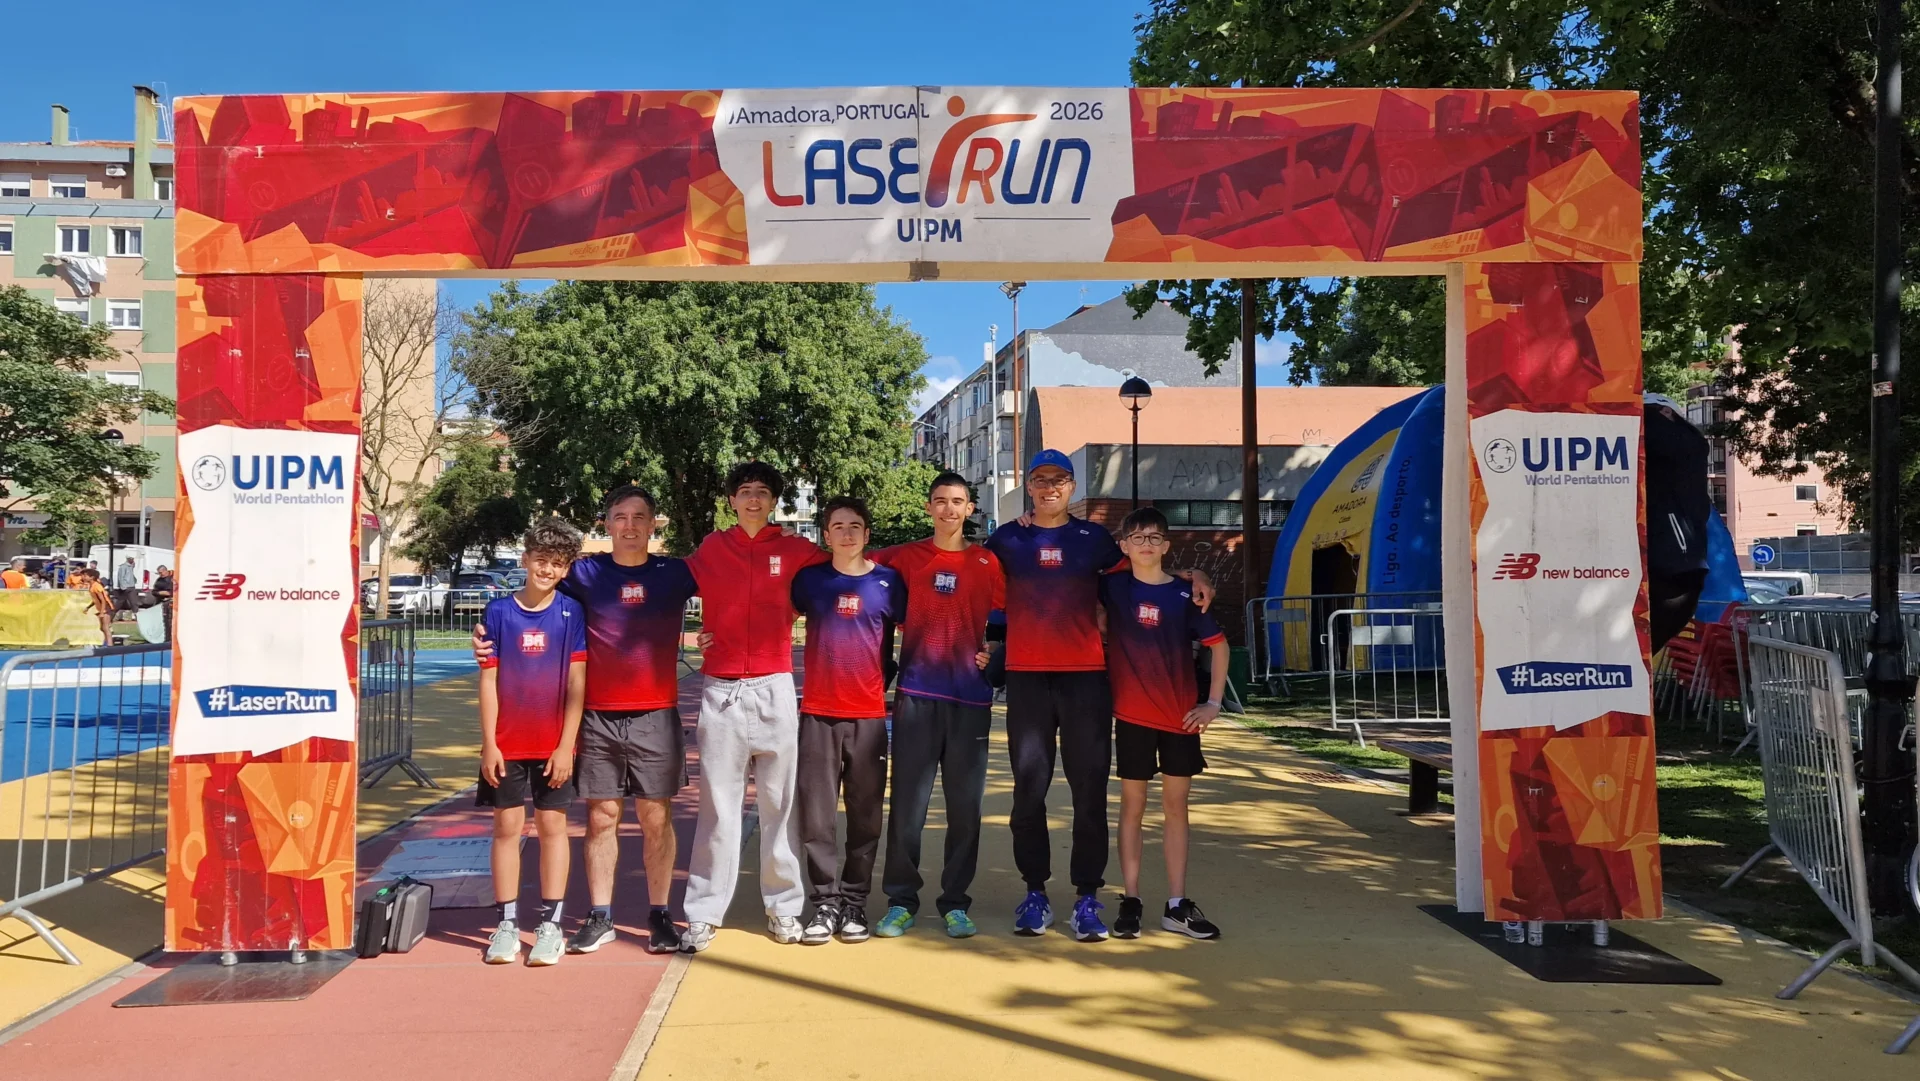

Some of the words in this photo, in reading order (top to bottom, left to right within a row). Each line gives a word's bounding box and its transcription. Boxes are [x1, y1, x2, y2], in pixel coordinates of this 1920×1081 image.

[836, 103, 930, 120] PORTUGAL
[1050, 101, 1103, 121] 2026
[897, 218, 963, 243] UIPM
[1522, 436, 1630, 471] UIPM
[232, 455, 344, 490] UIPM
[1525, 474, 1562, 486] World
[1564, 473, 1630, 486] Pentathlon
[233, 493, 271, 505] World
[275, 492, 344, 505] Pentathlon
[1332, 496, 1367, 514] AMADORA
[1386, 522, 1399, 542] Ao
[1542, 570, 1570, 579] new
[1573, 566, 1630, 579] balance
[247, 590, 276, 600] new
[280, 588, 340, 600] balance
[1511, 665, 1626, 687] #LaserRun
[208, 688, 331, 712] #LaserRun
